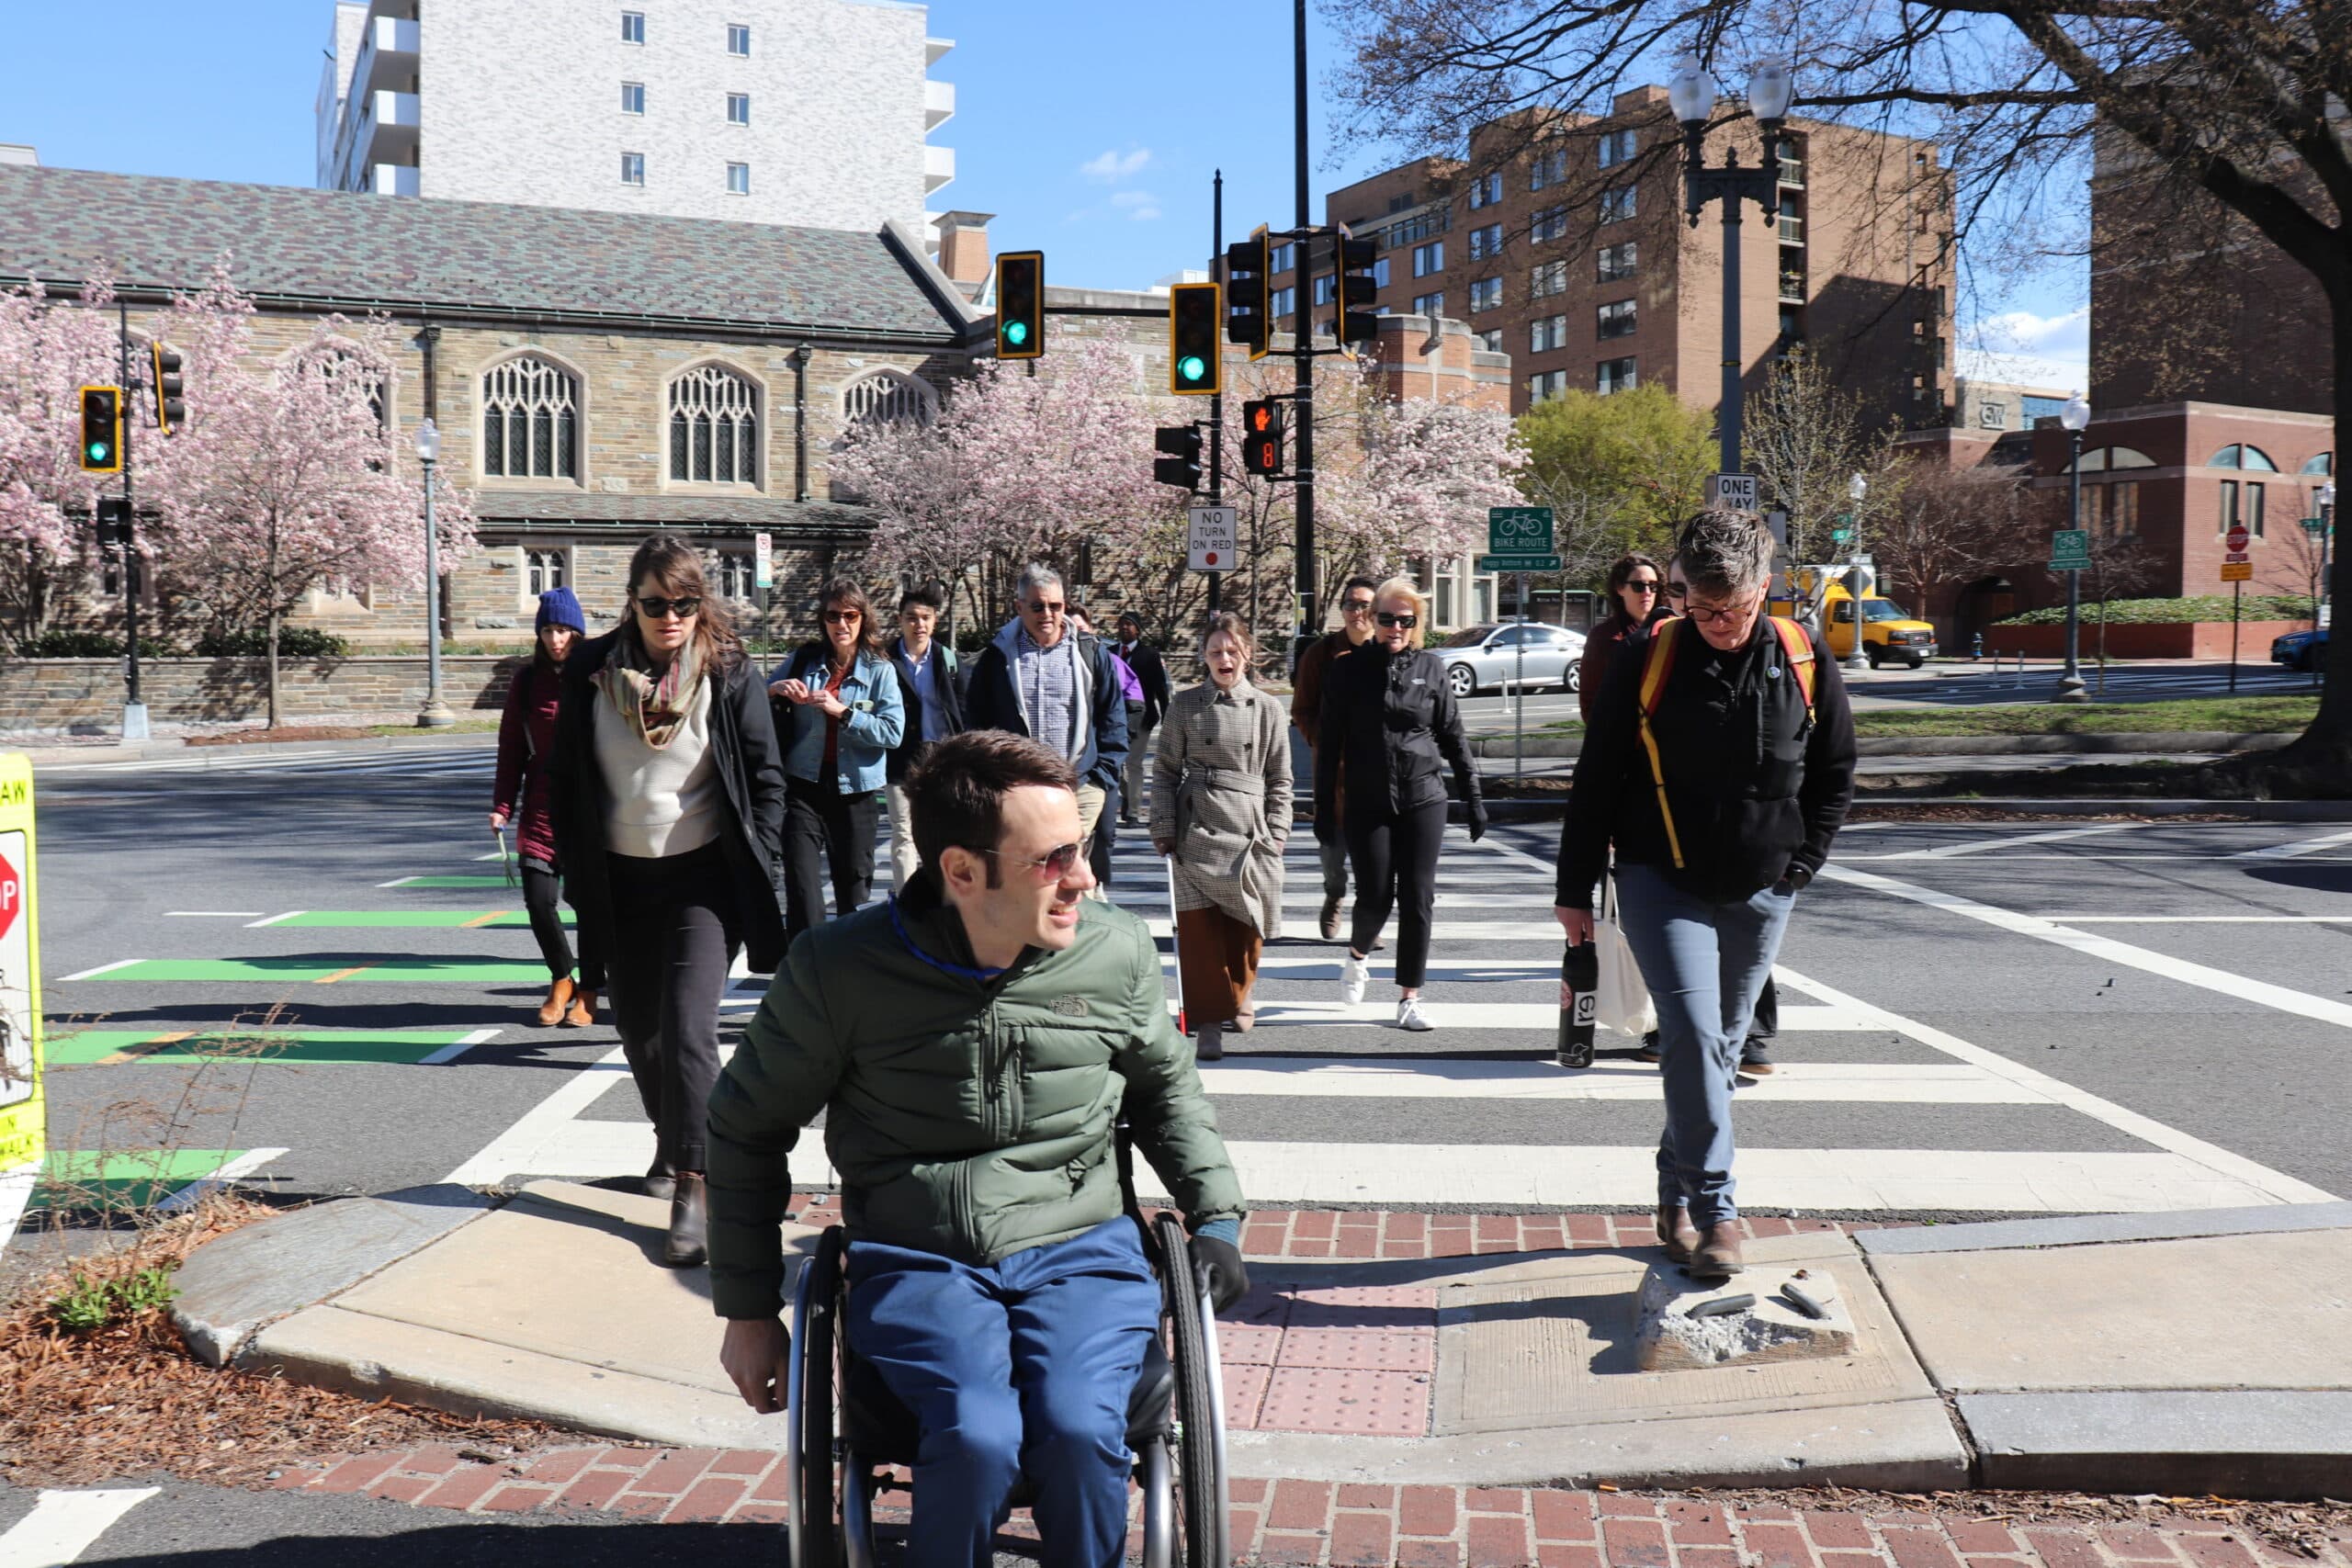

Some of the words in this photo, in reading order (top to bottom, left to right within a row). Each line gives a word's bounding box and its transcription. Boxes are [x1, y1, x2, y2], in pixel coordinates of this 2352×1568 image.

[1263, 443, 1273, 468] 8
[1721, 479, 1751, 495] ONE
[1202, 512, 1222, 524] NO
[1198, 526, 1226, 537] TURN
[1193, 540, 1206, 550] ON
[1212, 540, 1231, 550] RED
[1494, 537, 1515, 547] BIKE
[1518, 537, 1548, 547] ROUTE
